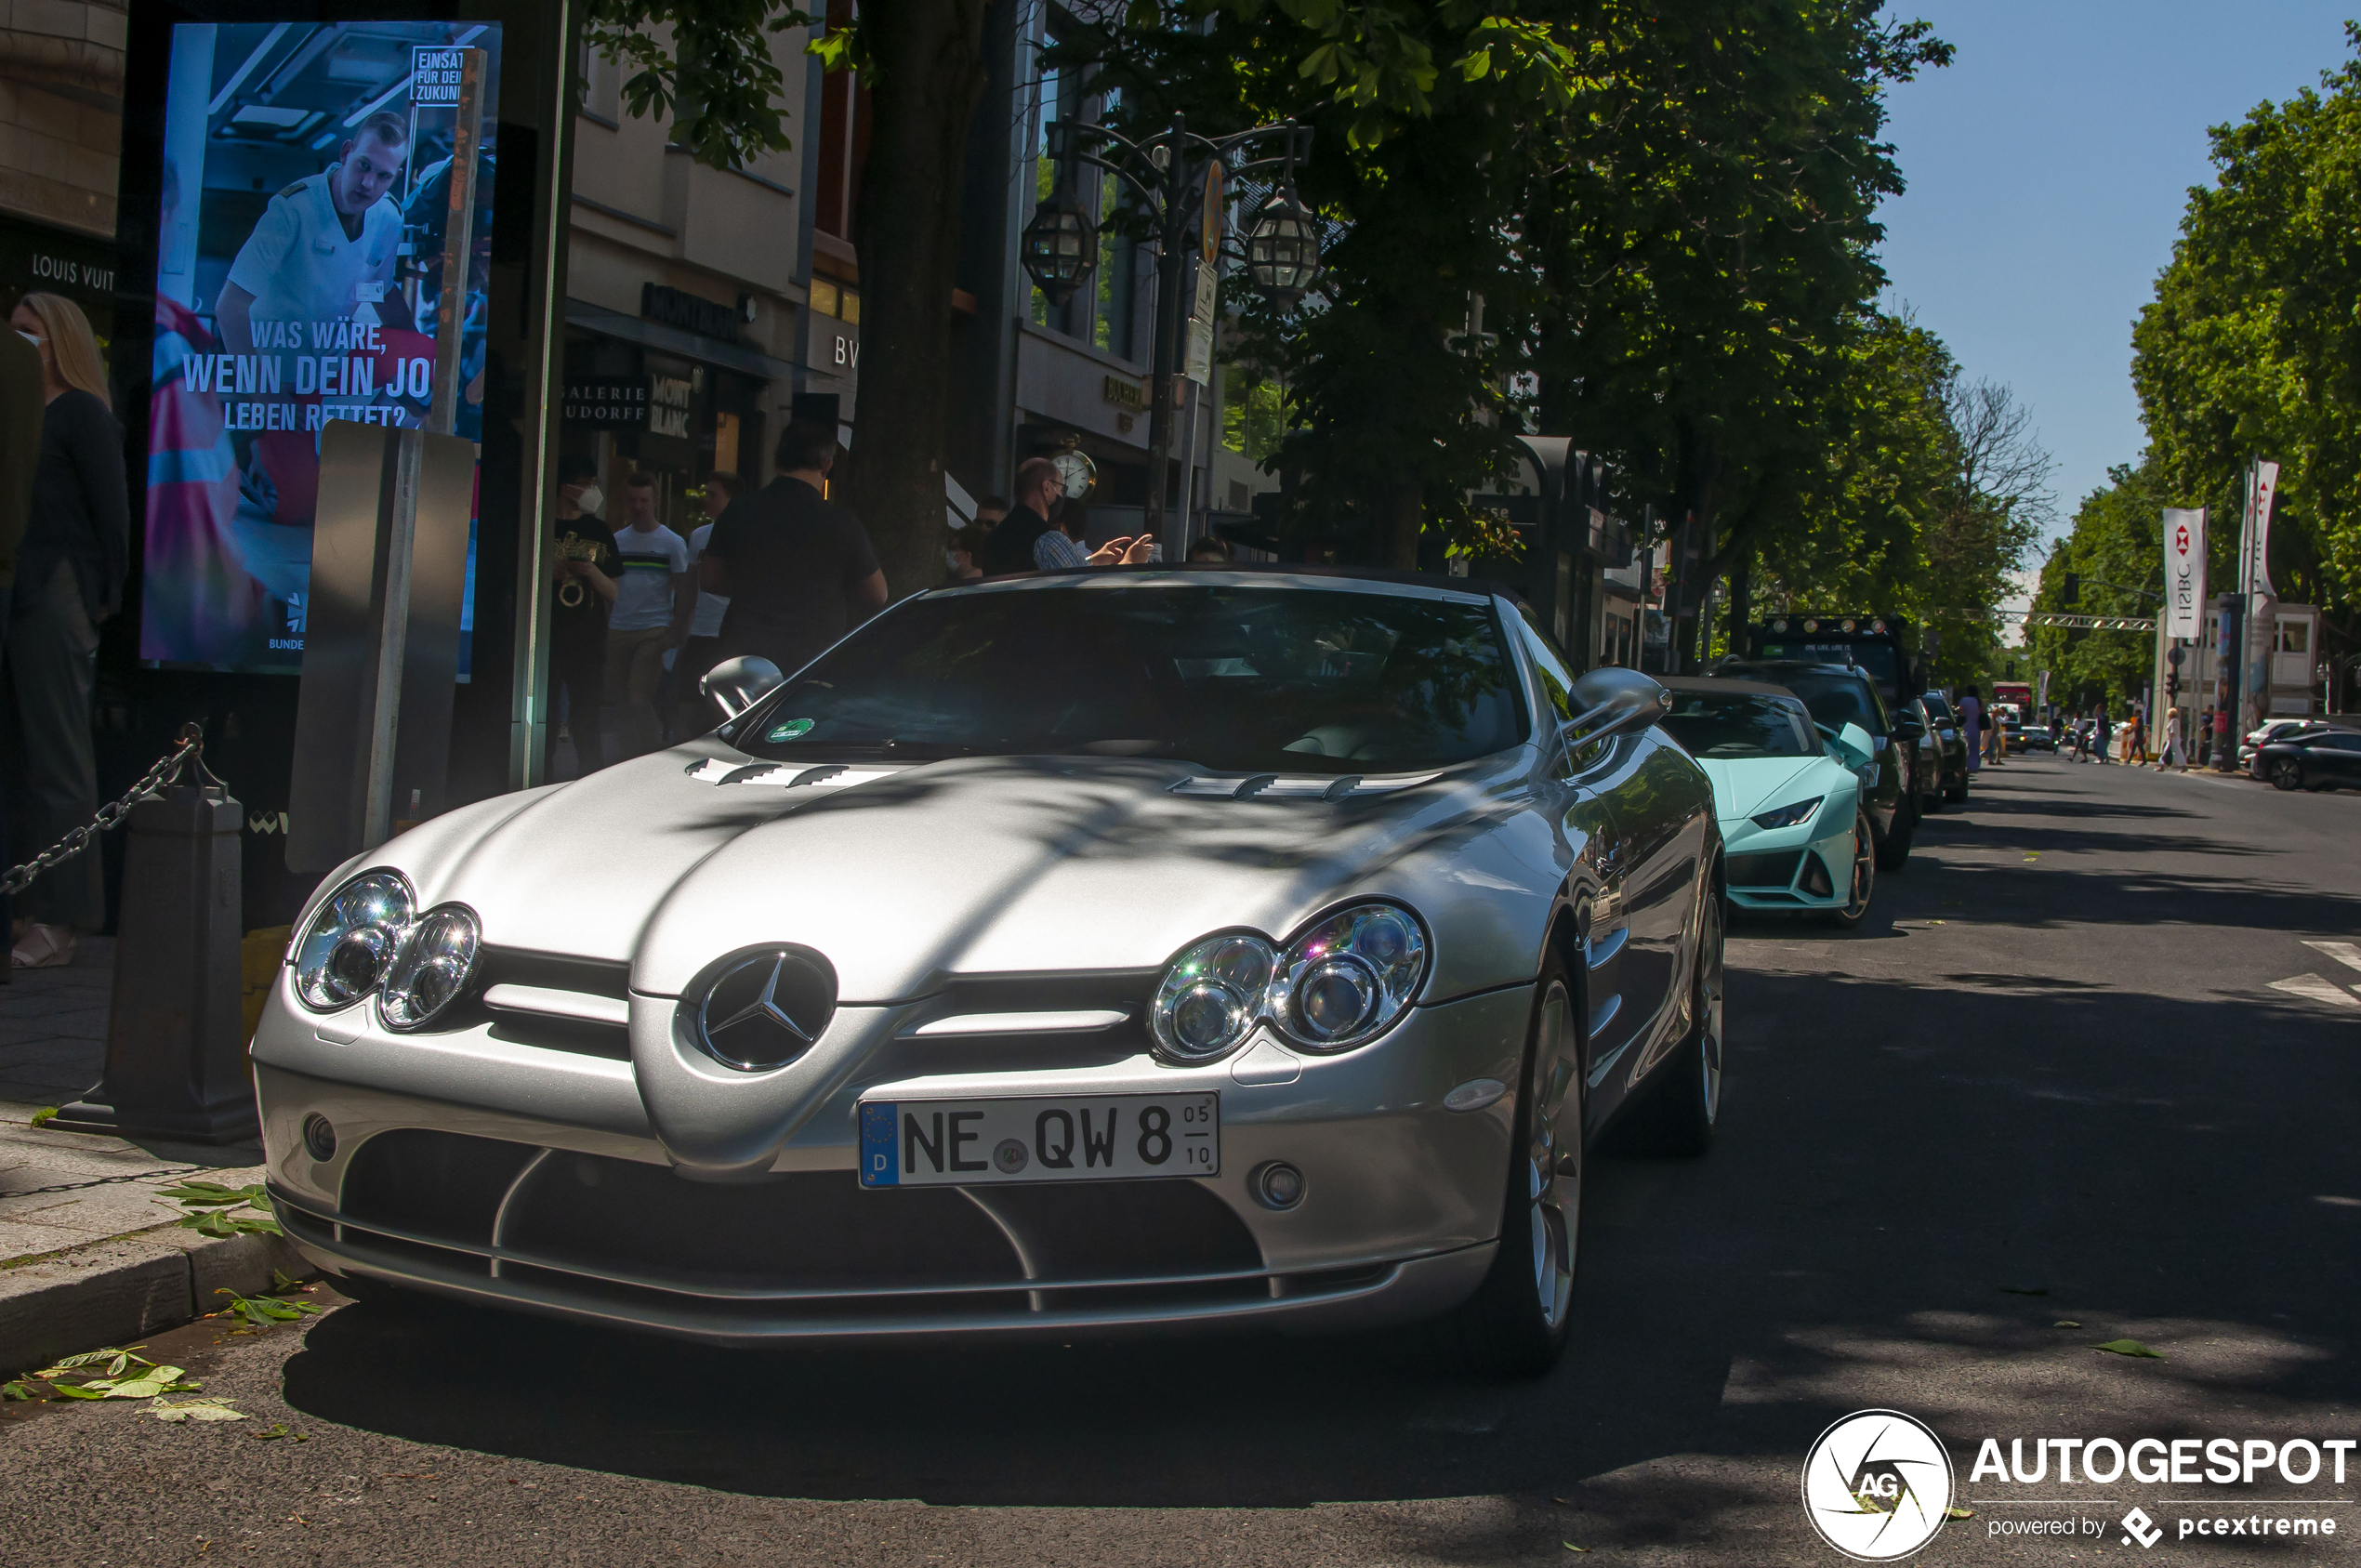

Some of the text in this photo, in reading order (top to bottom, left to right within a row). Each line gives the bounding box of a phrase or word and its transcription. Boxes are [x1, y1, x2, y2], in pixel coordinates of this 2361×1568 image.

[33, 253, 77, 283] LOUIS
[250, 315, 387, 355] WAS WÄRE,
[183, 353, 437, 399] WENN DEIN JO
[652, 373, 692, 409] MONT
[224, 402, 297, 431] LEBEN
[651, 404, 690, 440] BLANC
[1184, 1106, 1209, 1123] 05
[904, 1105, 1173, 1173] NE QW 8
[874, 1153, 888, 1171] D
[1187, 1147, 1209, 1165] 10
